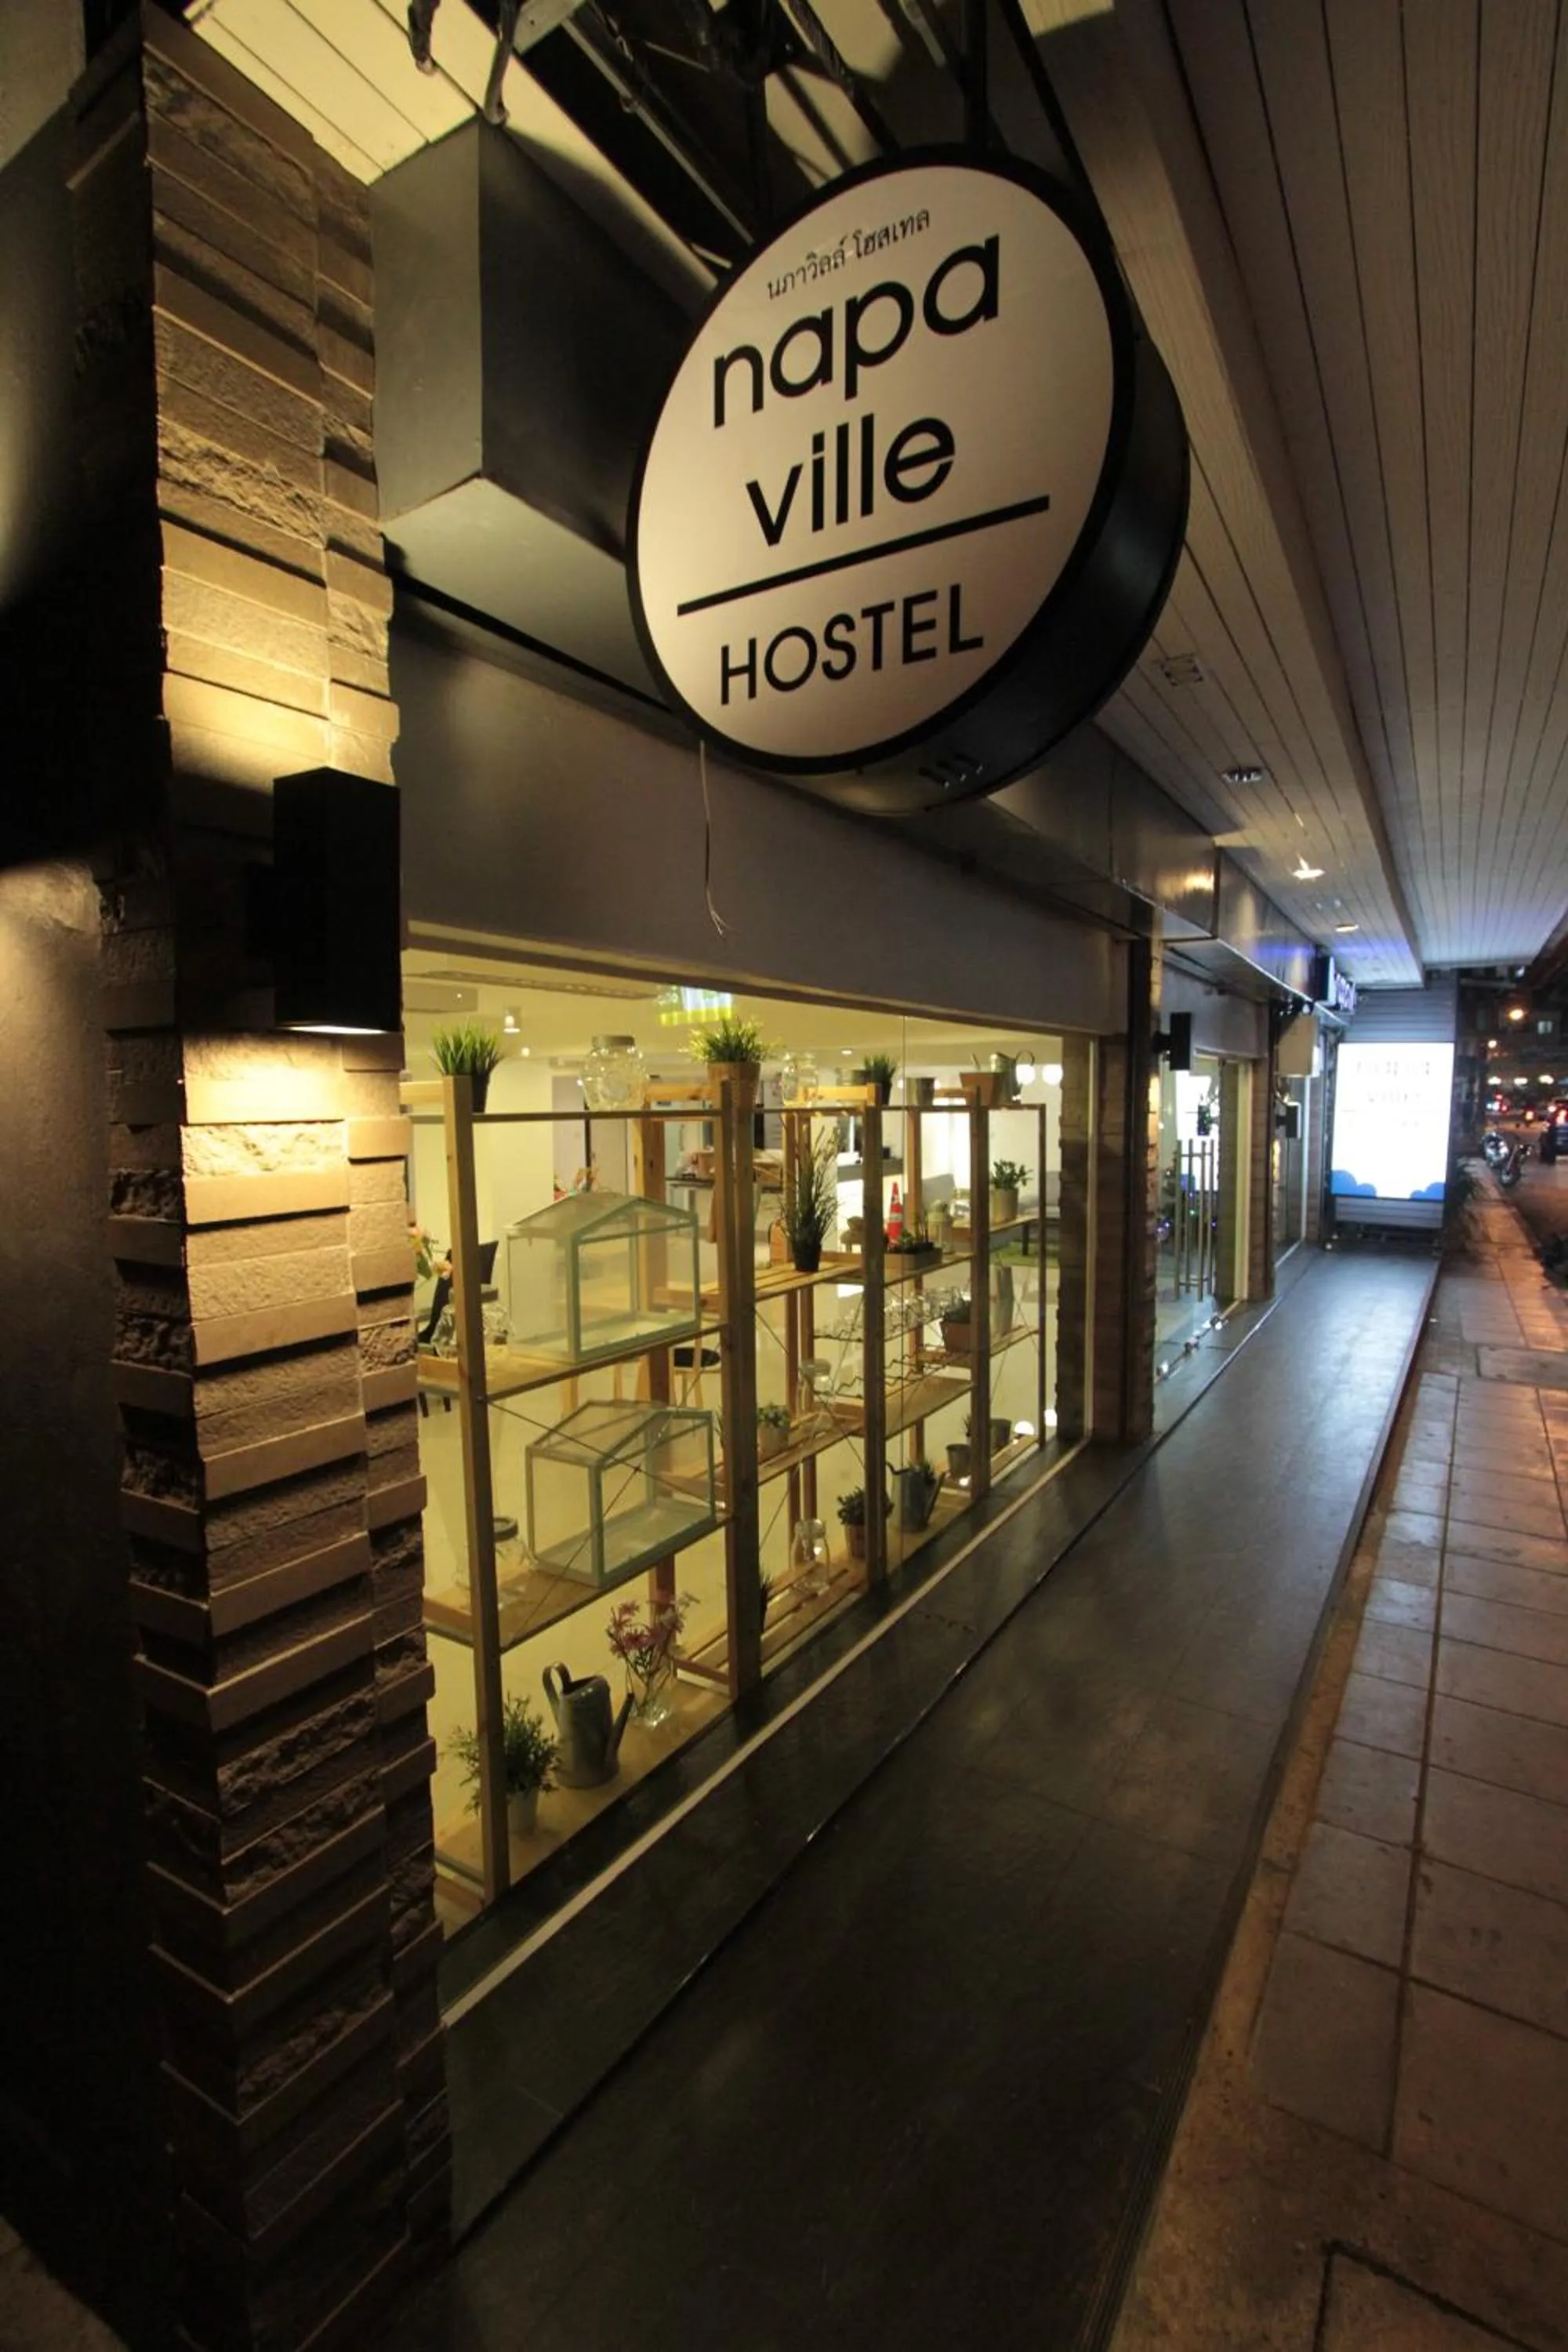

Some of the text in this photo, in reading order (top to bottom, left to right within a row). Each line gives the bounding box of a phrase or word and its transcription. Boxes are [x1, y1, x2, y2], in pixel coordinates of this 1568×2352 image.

[713, 234, 1000, 429] napa
[746, 412, 956, 547] ville
[720, 583, 984, 705] HOSTEL
